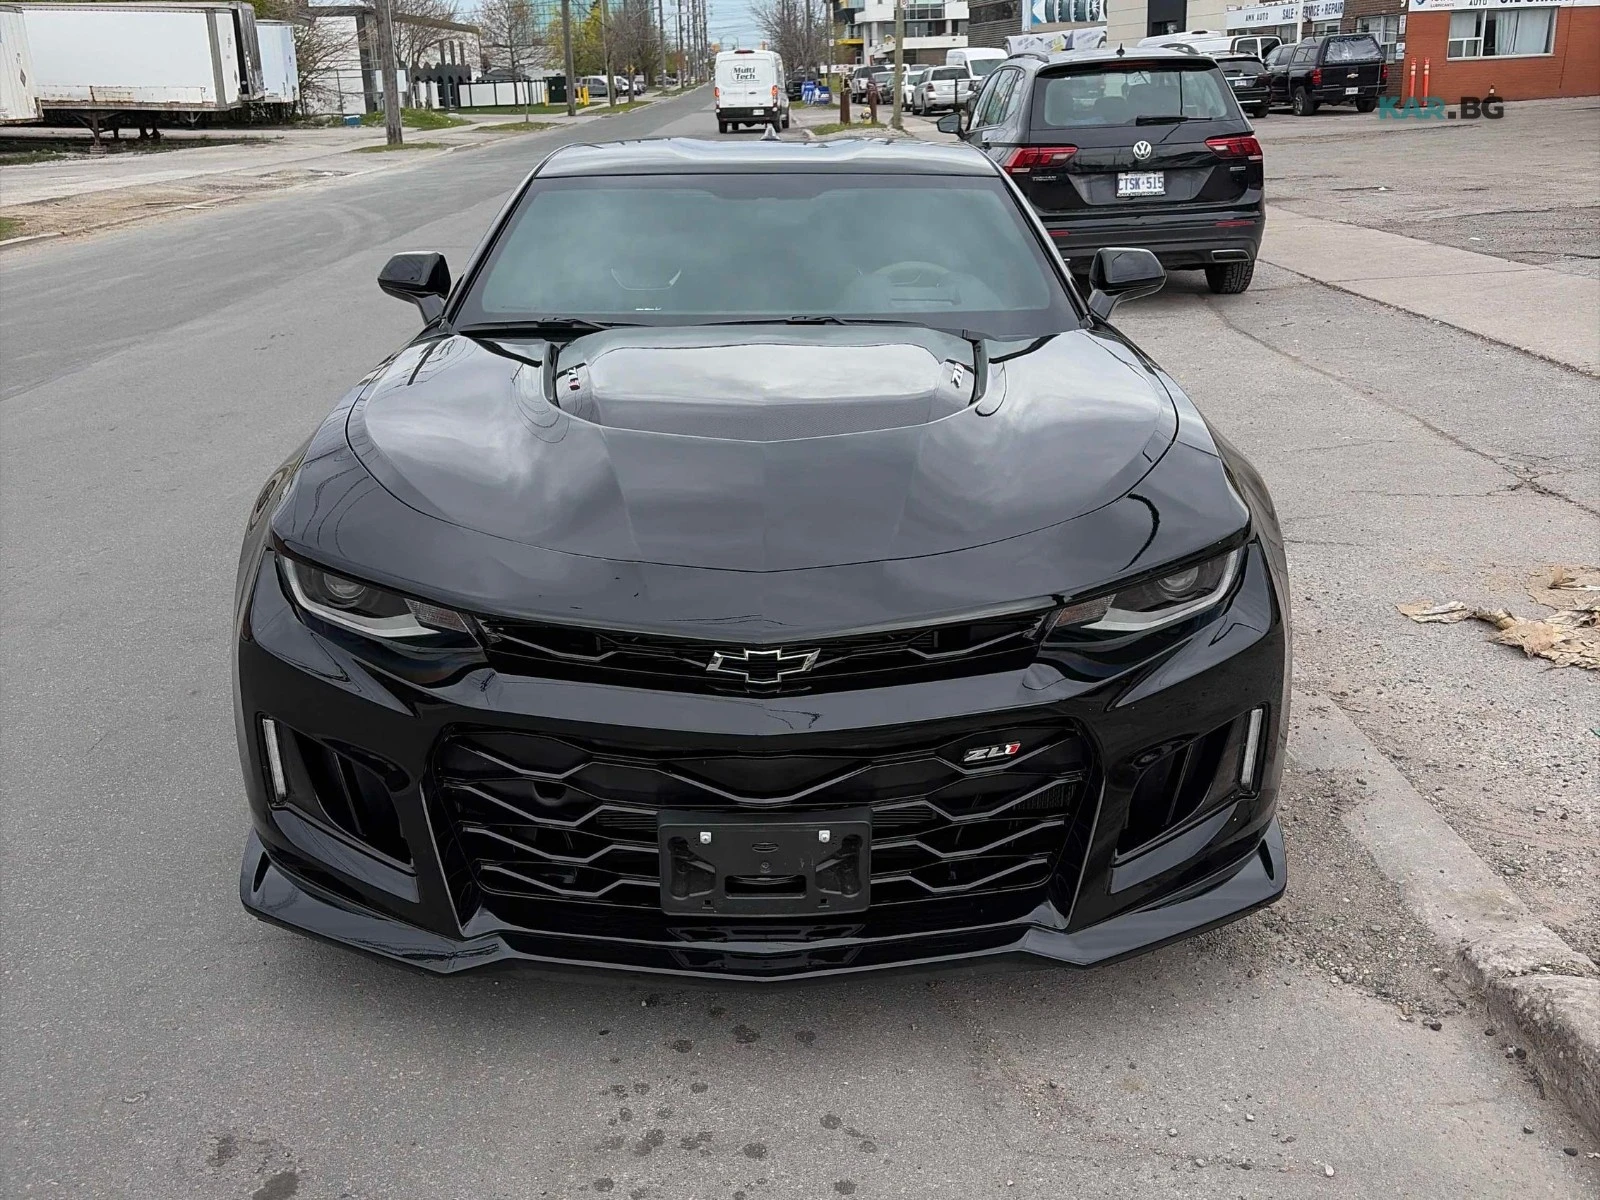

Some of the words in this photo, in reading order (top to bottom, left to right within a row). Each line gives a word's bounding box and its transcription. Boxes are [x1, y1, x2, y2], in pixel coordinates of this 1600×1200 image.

[1282, 8, 1295, 20] SALE
[1302, 4, 1320, 18] ERVICE
[1324, 2, 1344, 15] REPAIR
[963, 743, 1021, 762] ZL1
